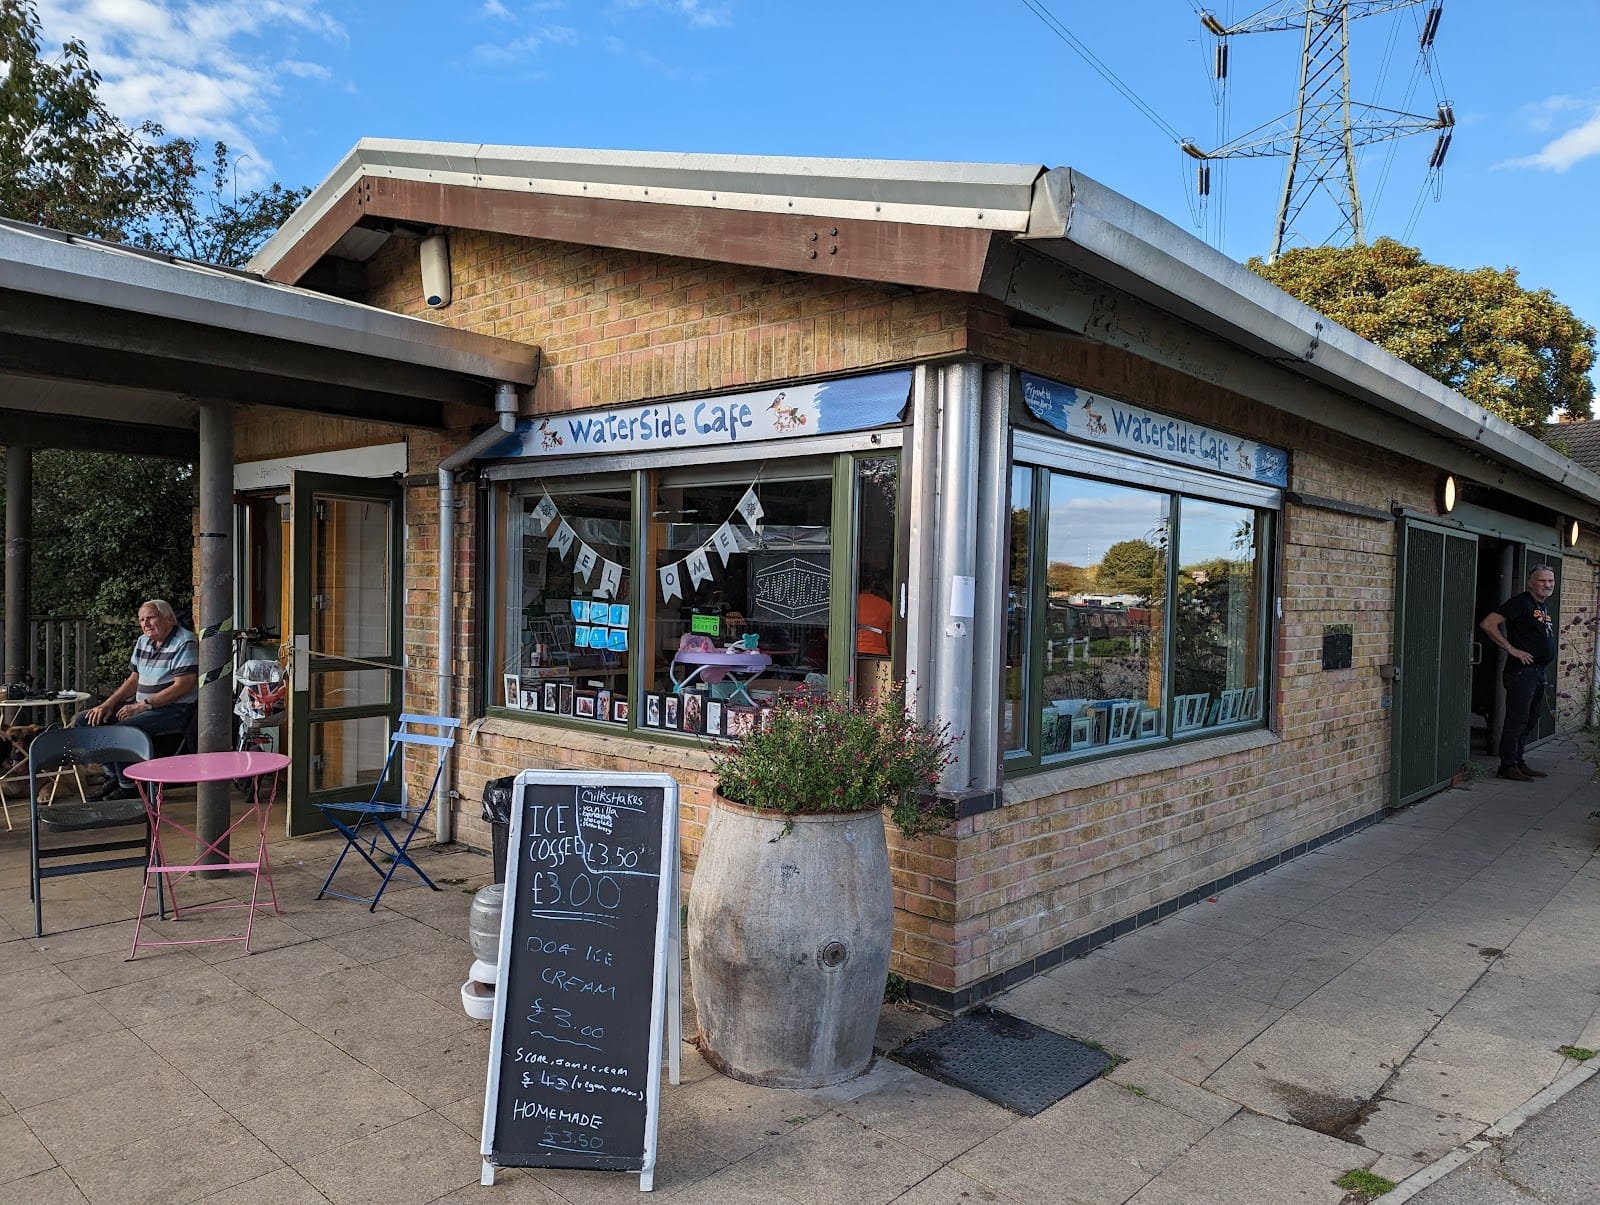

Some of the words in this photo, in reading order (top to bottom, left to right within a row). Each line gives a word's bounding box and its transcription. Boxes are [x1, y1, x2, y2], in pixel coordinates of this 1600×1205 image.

[693, 402, 753, 440] Cafe
[1199, 430, 1230, 470] Cafe
[529, 805, 570, 837] ICE
[582, 805, 619, 818] vanilla
[587, 842, 639, 868] £3.50
[531, 871, 622, 909] £3.00
[526, 936, 576, 956] DOG
[585, 945, 614, 967] ICE
[541, 967, 616, 1001] CREAM
[526, 997, 605, 1039] £3.00
[591, 1065, 628, 1077] cream
[513, 1098, 604, 1130] HOMEMADE
[542, 1125, 604, 1149] £3.50
